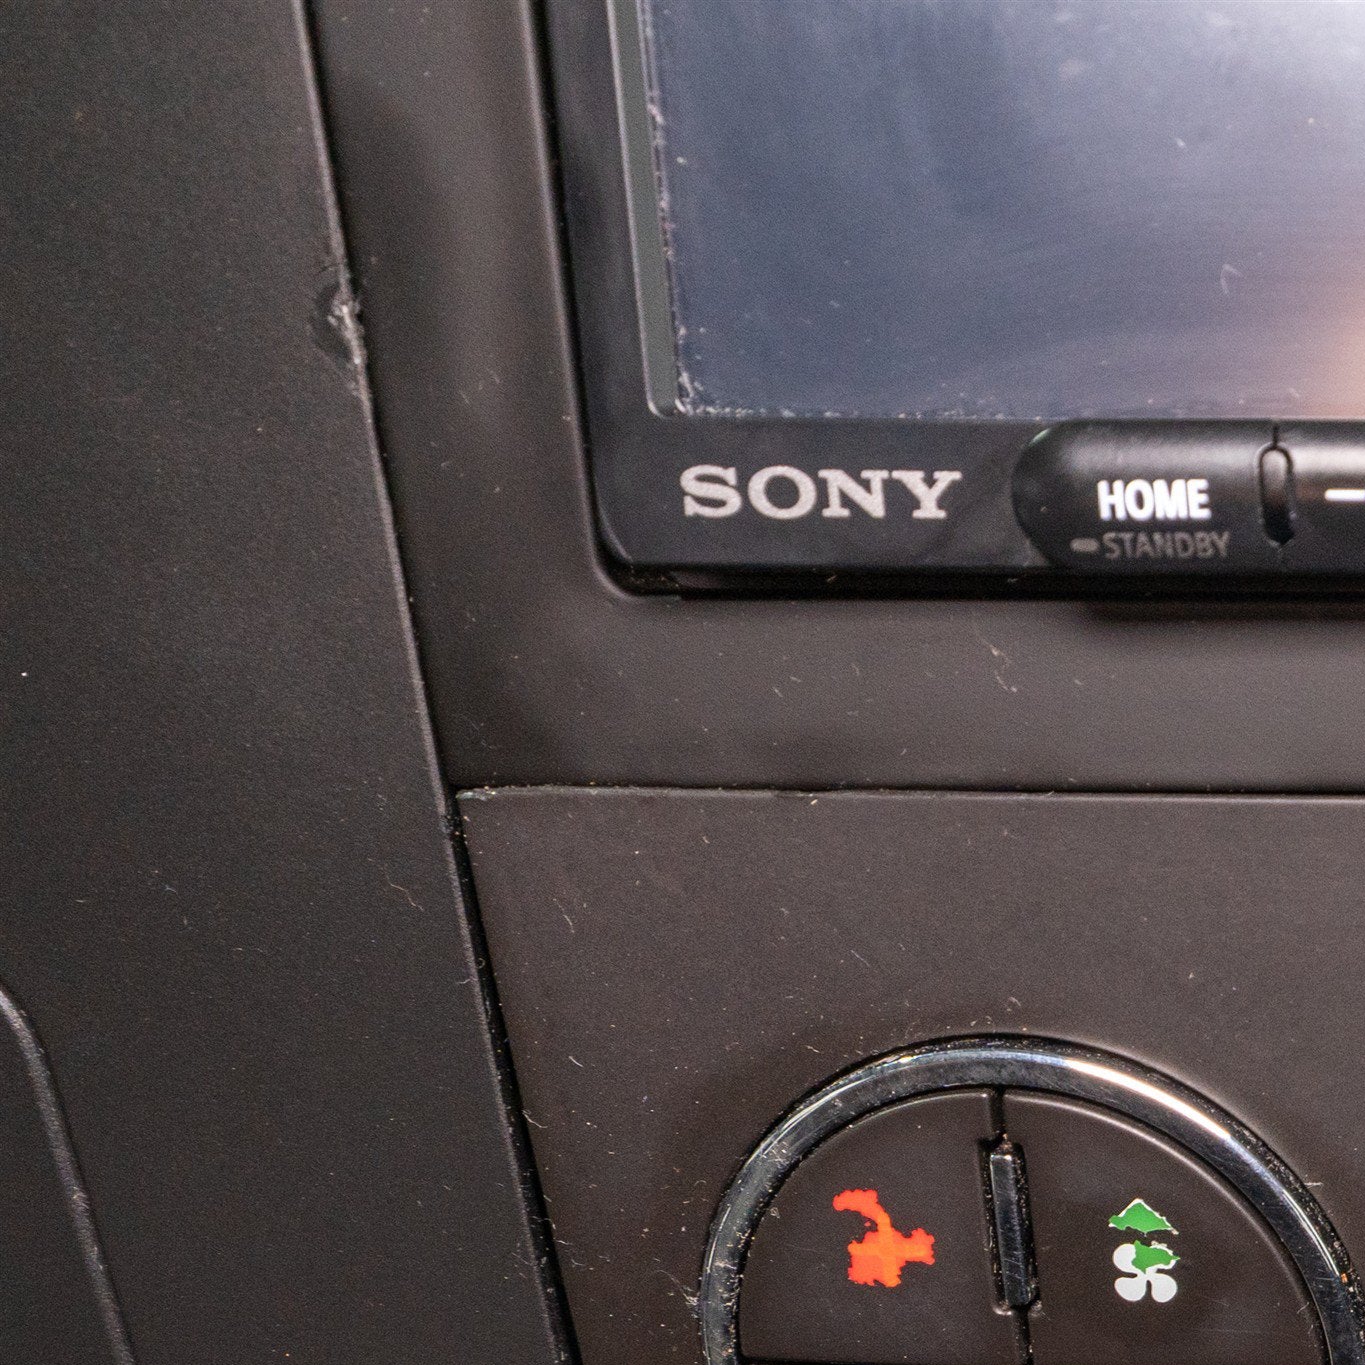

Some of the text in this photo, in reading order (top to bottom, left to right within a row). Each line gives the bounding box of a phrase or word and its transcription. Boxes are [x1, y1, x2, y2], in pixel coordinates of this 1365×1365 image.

[680, 464, 961, 519] SONY
[1097, 479, 1210, 520] HOME
[1102, 531, 1230, 559] STANDBY
